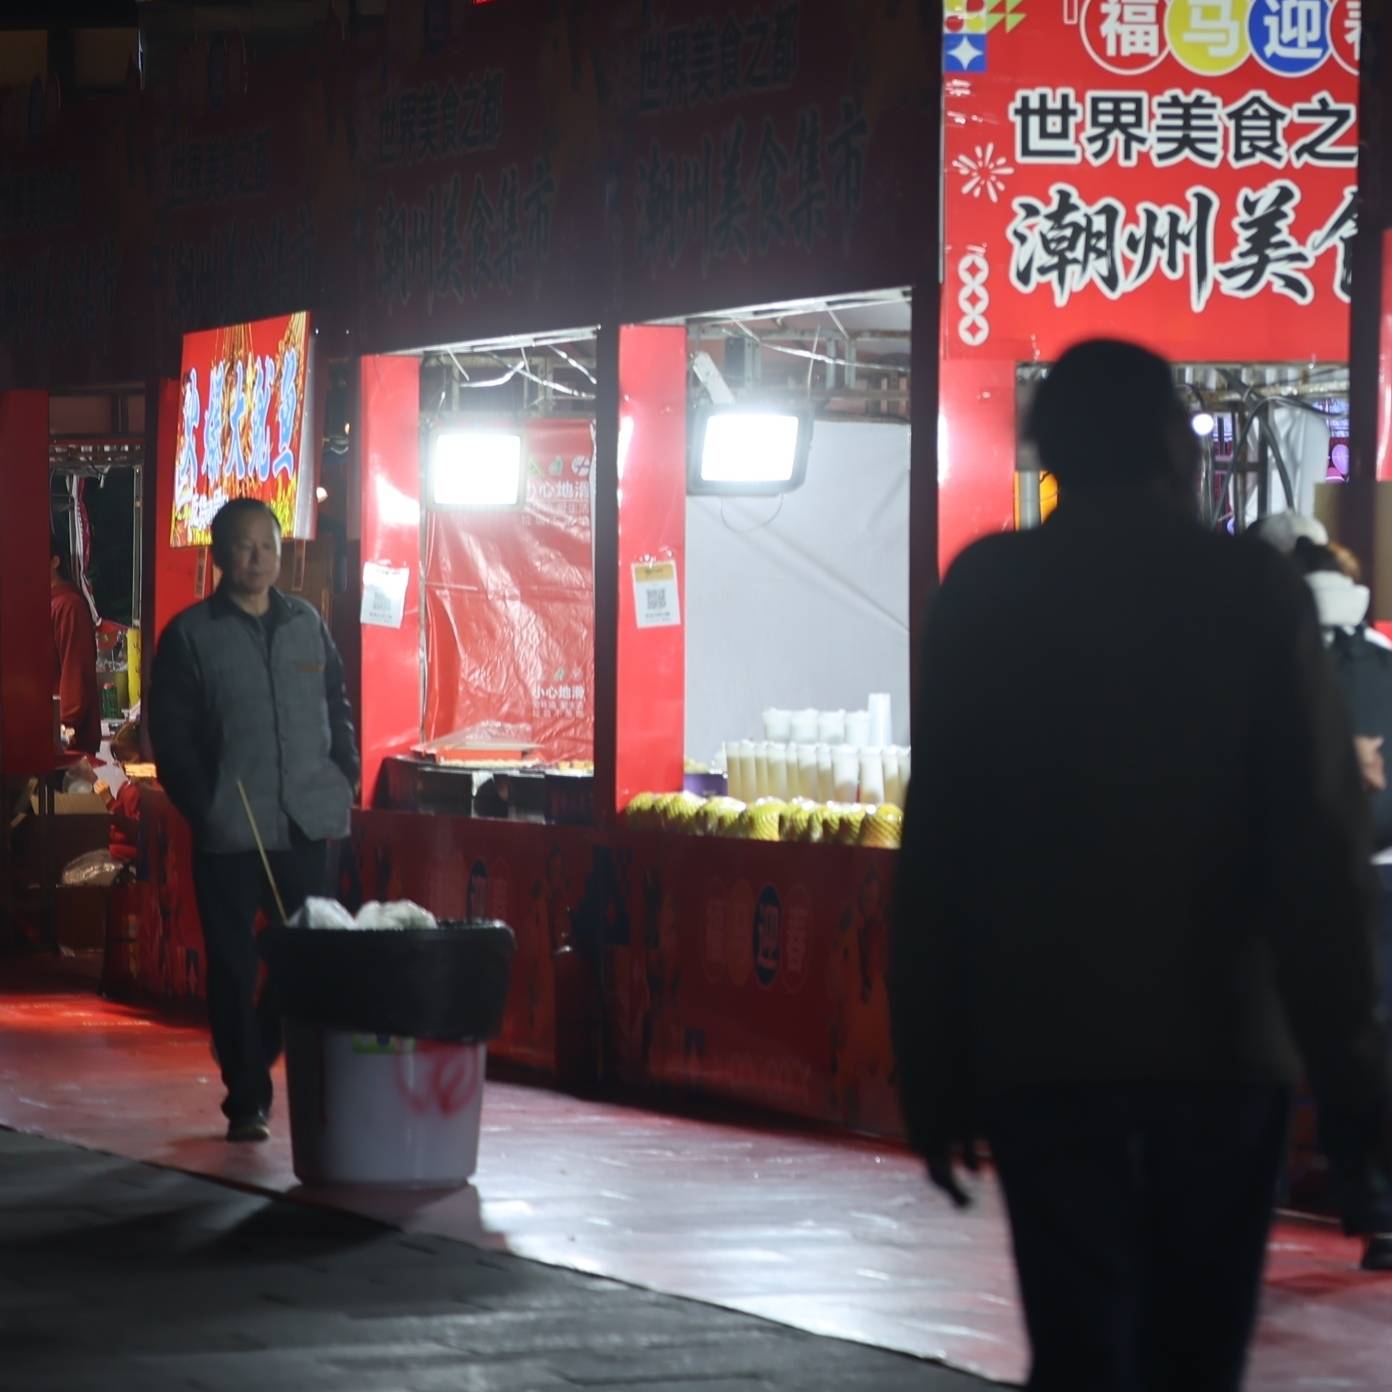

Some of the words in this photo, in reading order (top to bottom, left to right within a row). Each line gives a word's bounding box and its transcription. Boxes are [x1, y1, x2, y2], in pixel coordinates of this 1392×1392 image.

[1012, 90, 1358, 164] 世界美食之
